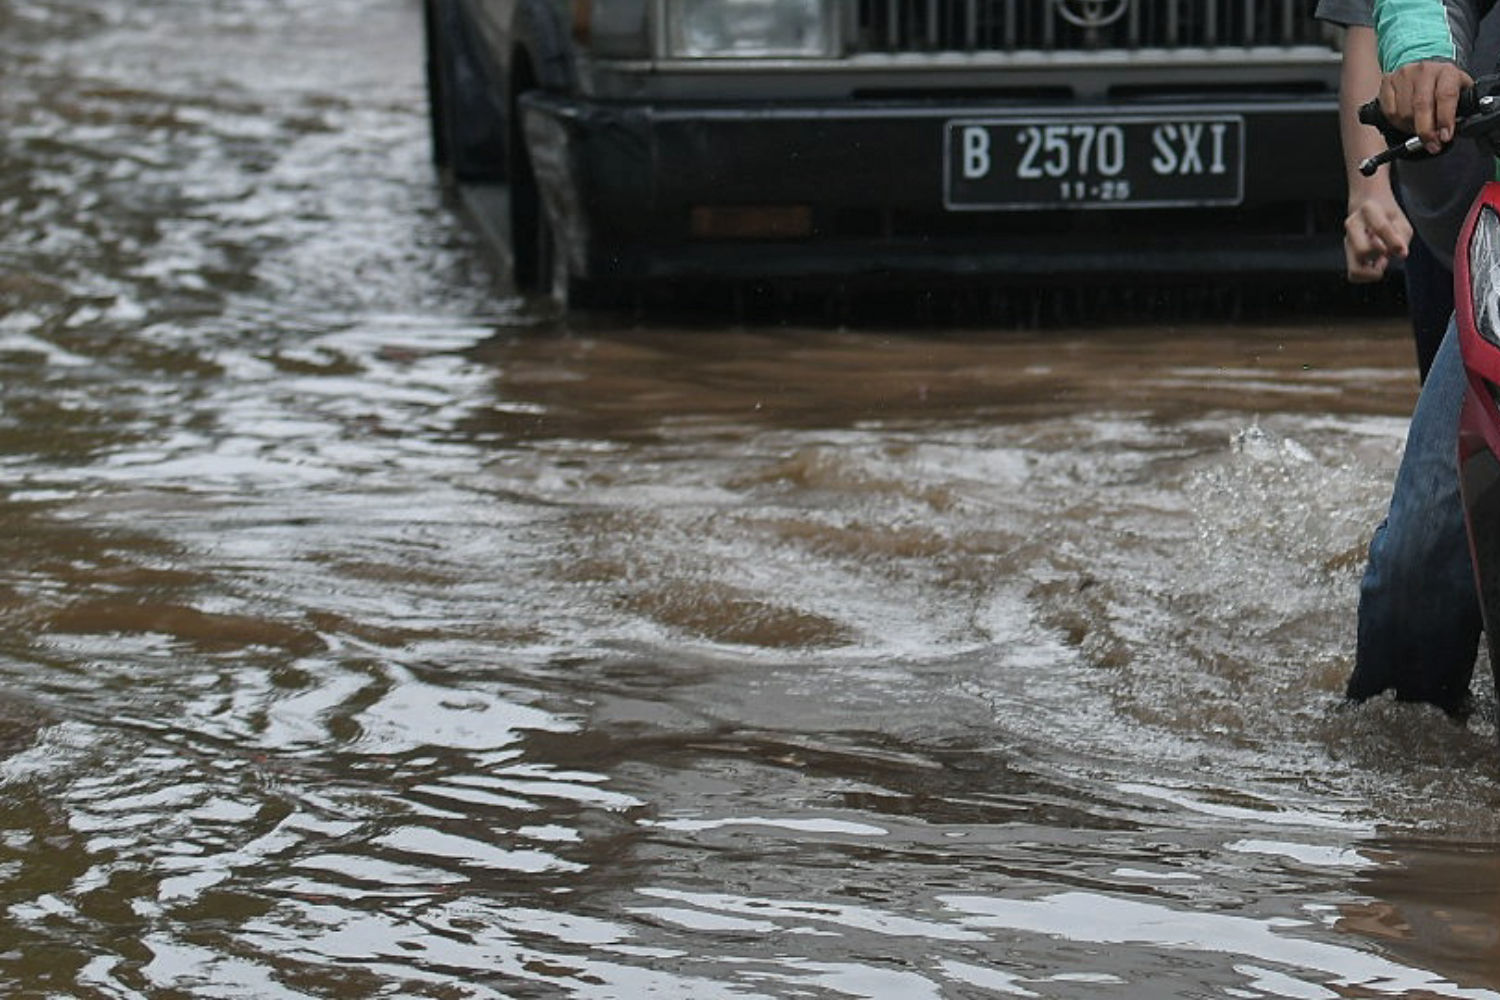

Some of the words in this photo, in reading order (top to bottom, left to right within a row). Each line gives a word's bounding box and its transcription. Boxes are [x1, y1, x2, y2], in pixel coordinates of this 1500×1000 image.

[963, 126, 990, 178] B
[1017, 124, 1125, 178] 2570
[1152, 123, 1226, 175] SXI
